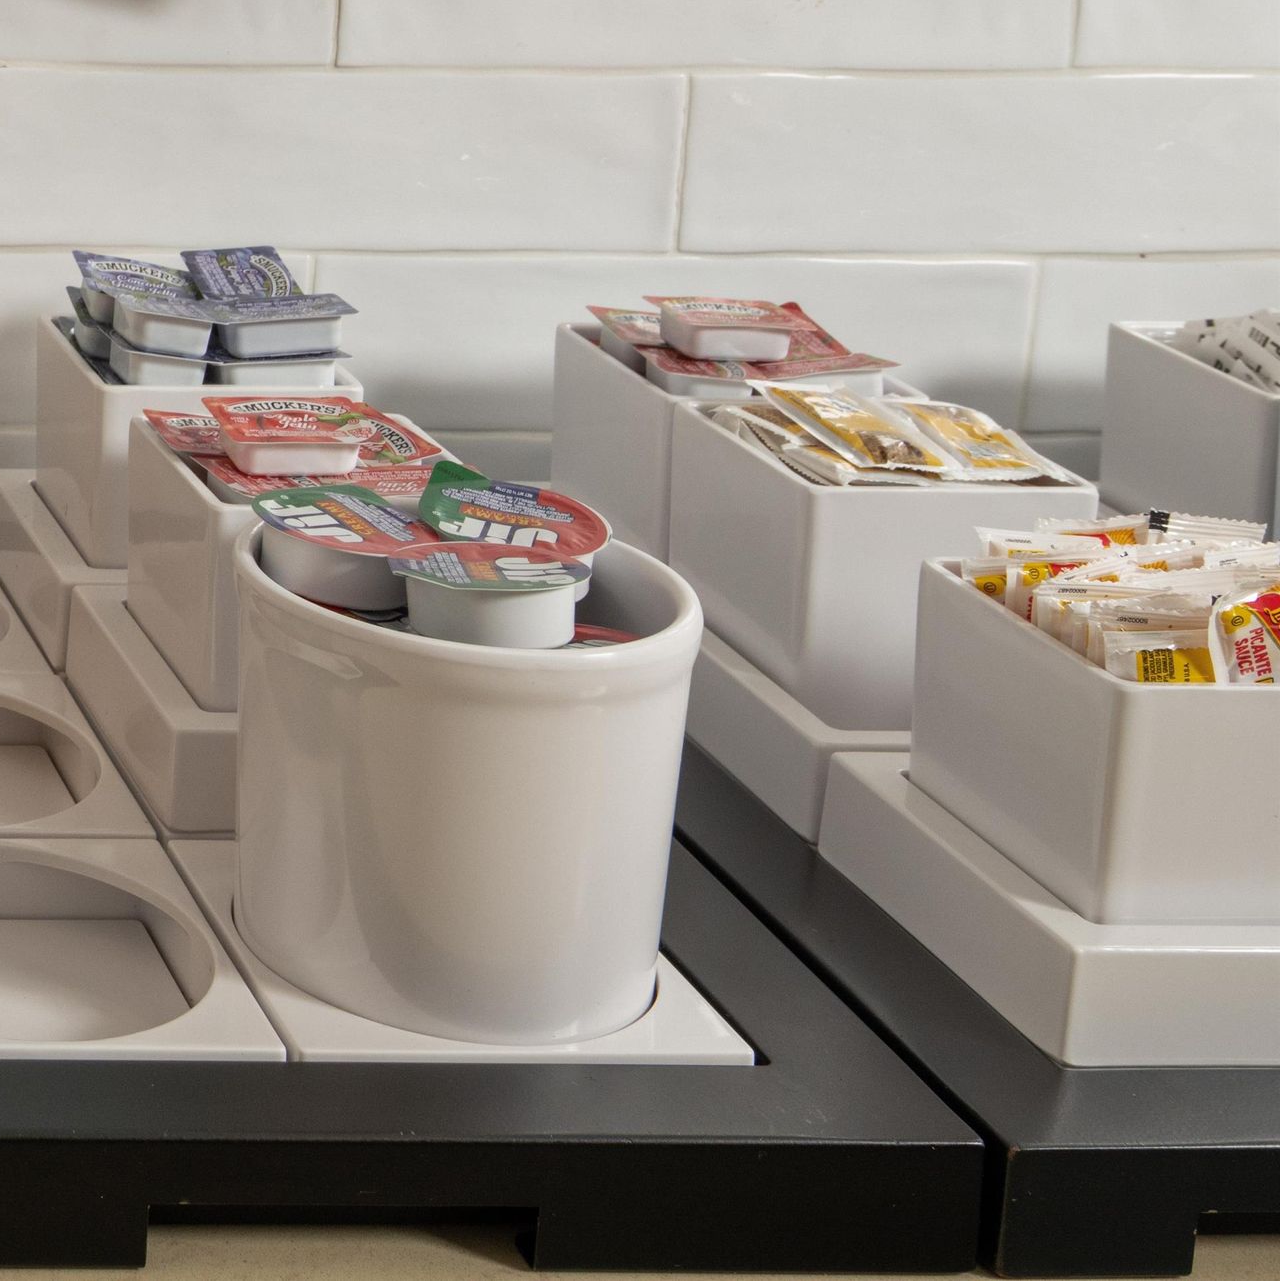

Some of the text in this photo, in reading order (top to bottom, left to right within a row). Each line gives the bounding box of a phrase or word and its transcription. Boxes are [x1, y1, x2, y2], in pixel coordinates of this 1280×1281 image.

[95, 262, 182, 285] SMUCKER'S
[233, 400, 337, 415] SMUCKER'S
[1234, 637, 1255, 676] SAUCE
[1249, 626, 1273, 677] PICANTE
